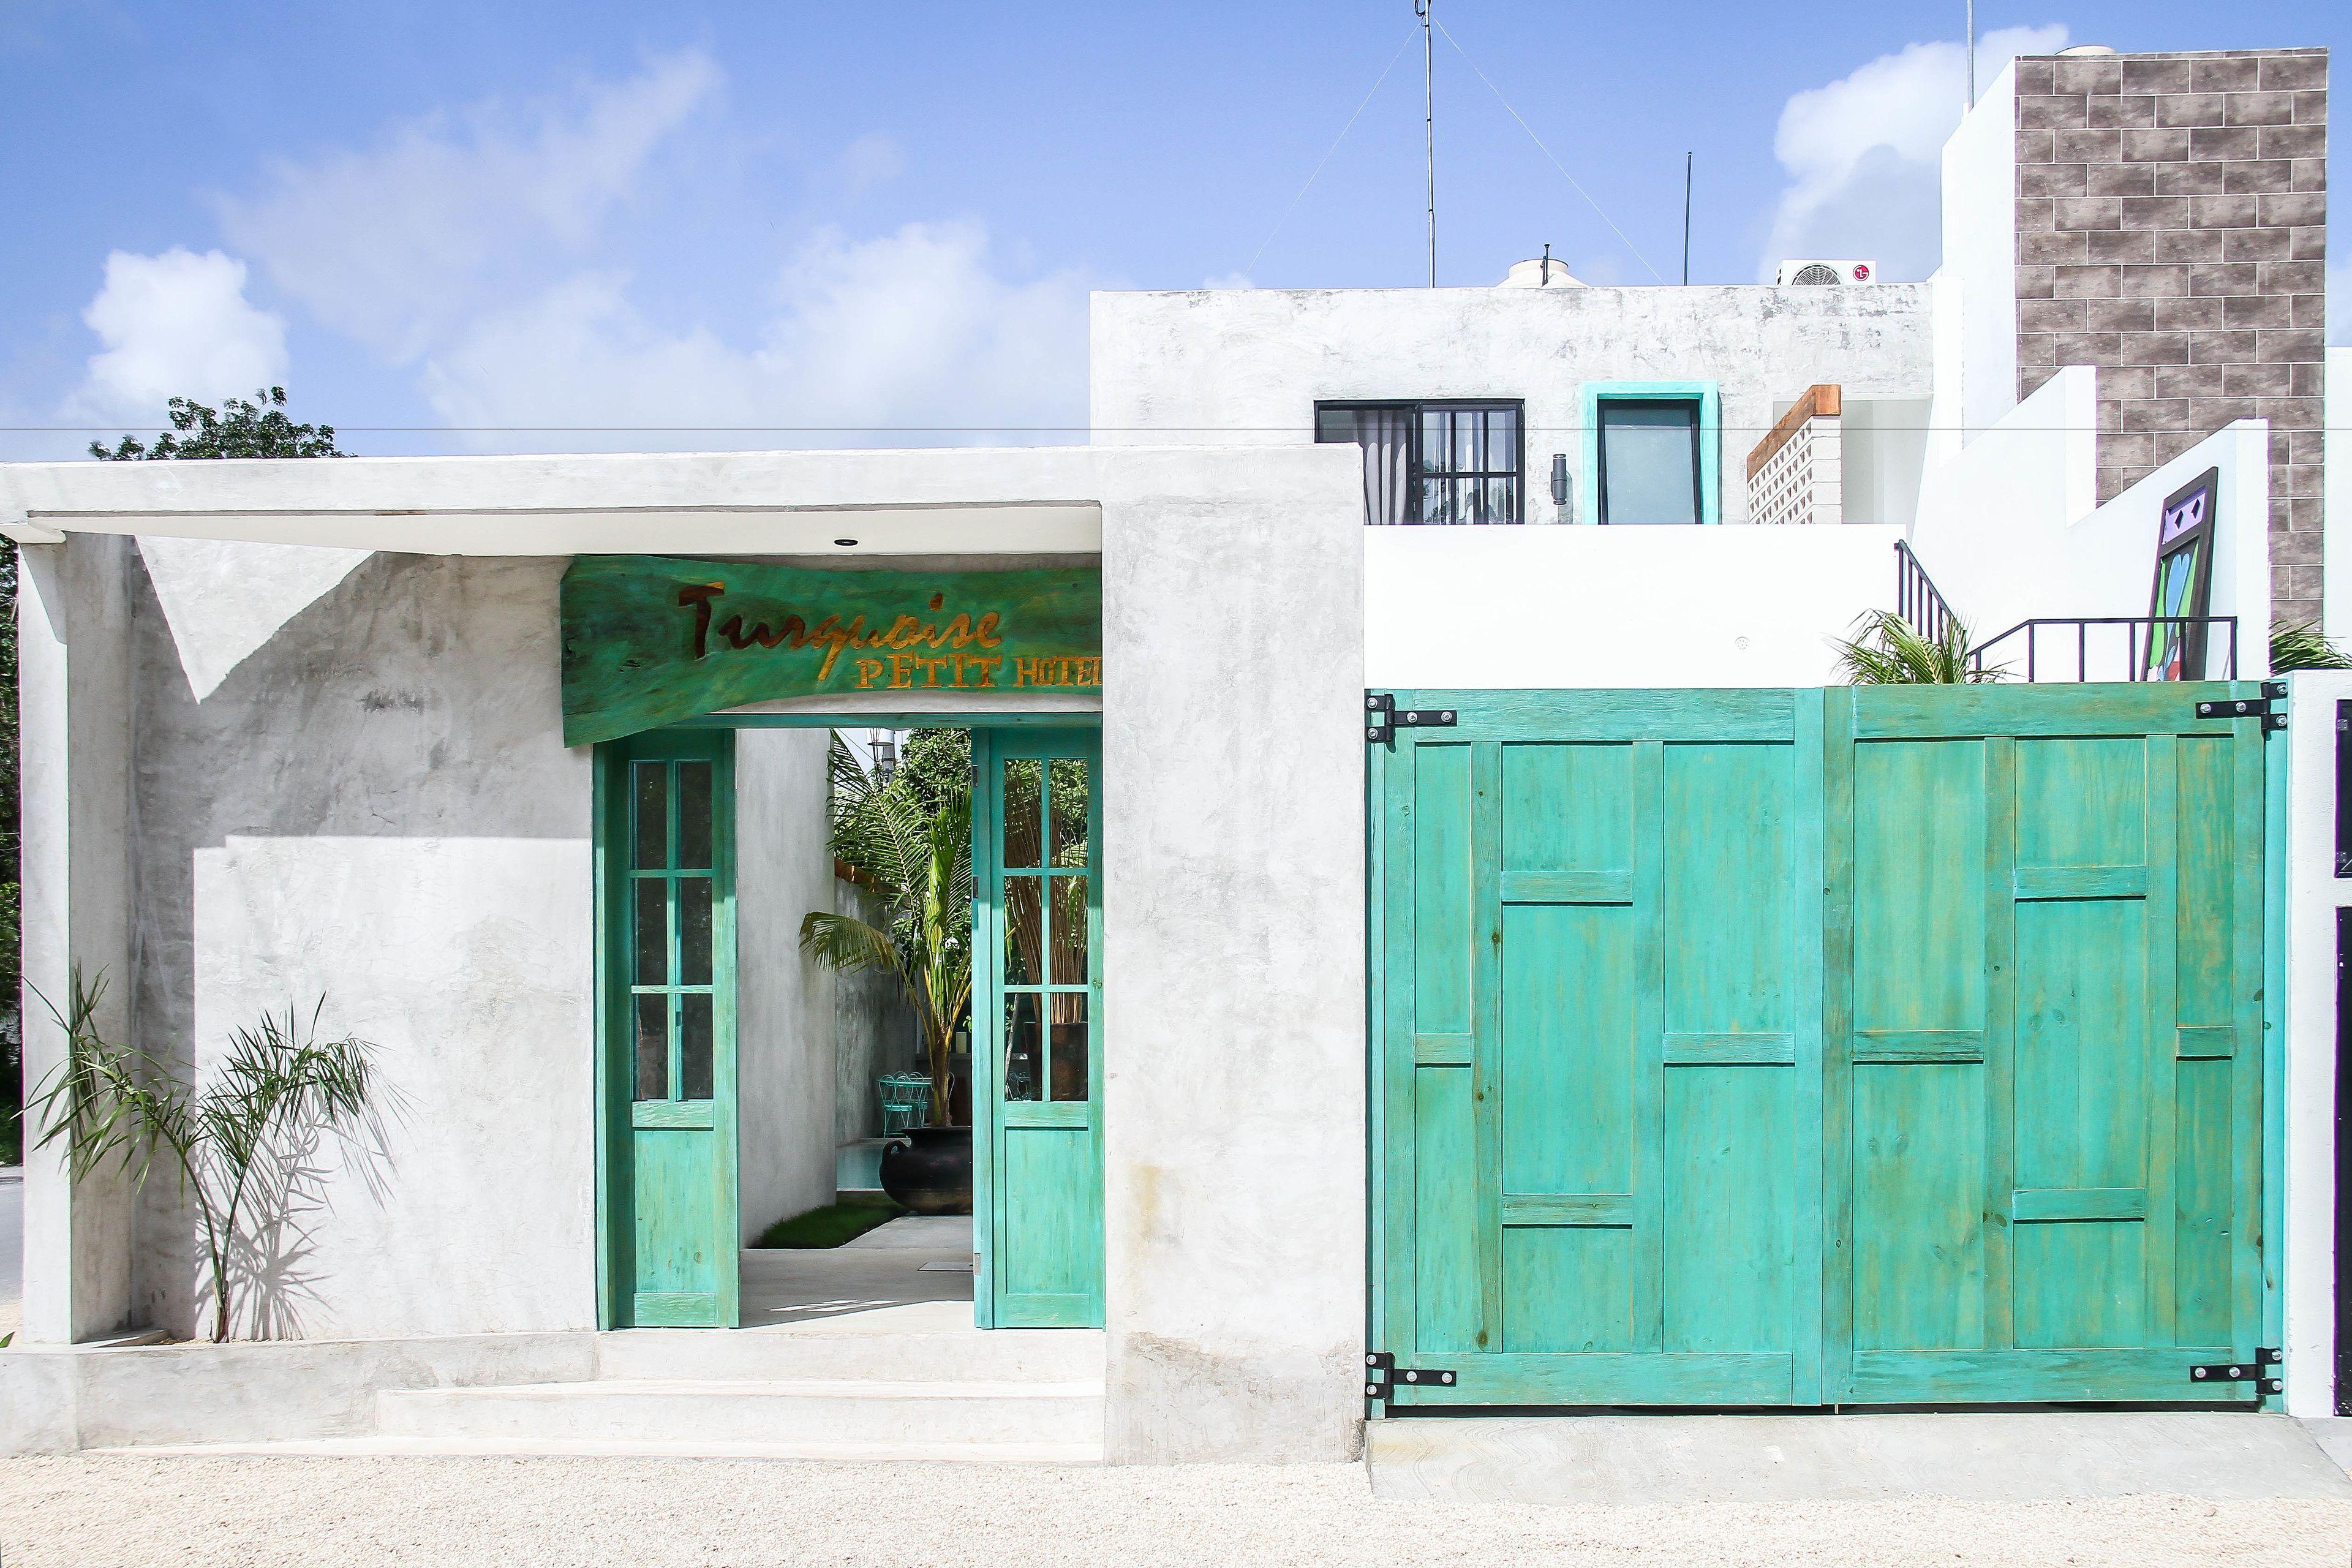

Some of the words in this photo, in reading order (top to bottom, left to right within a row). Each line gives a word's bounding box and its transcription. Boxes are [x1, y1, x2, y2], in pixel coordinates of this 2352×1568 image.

[1853, 265, 1869, 281] LG
[678, 581, 1002, 680] Turquoise
[854, 650, 1003, 688] PETIT
